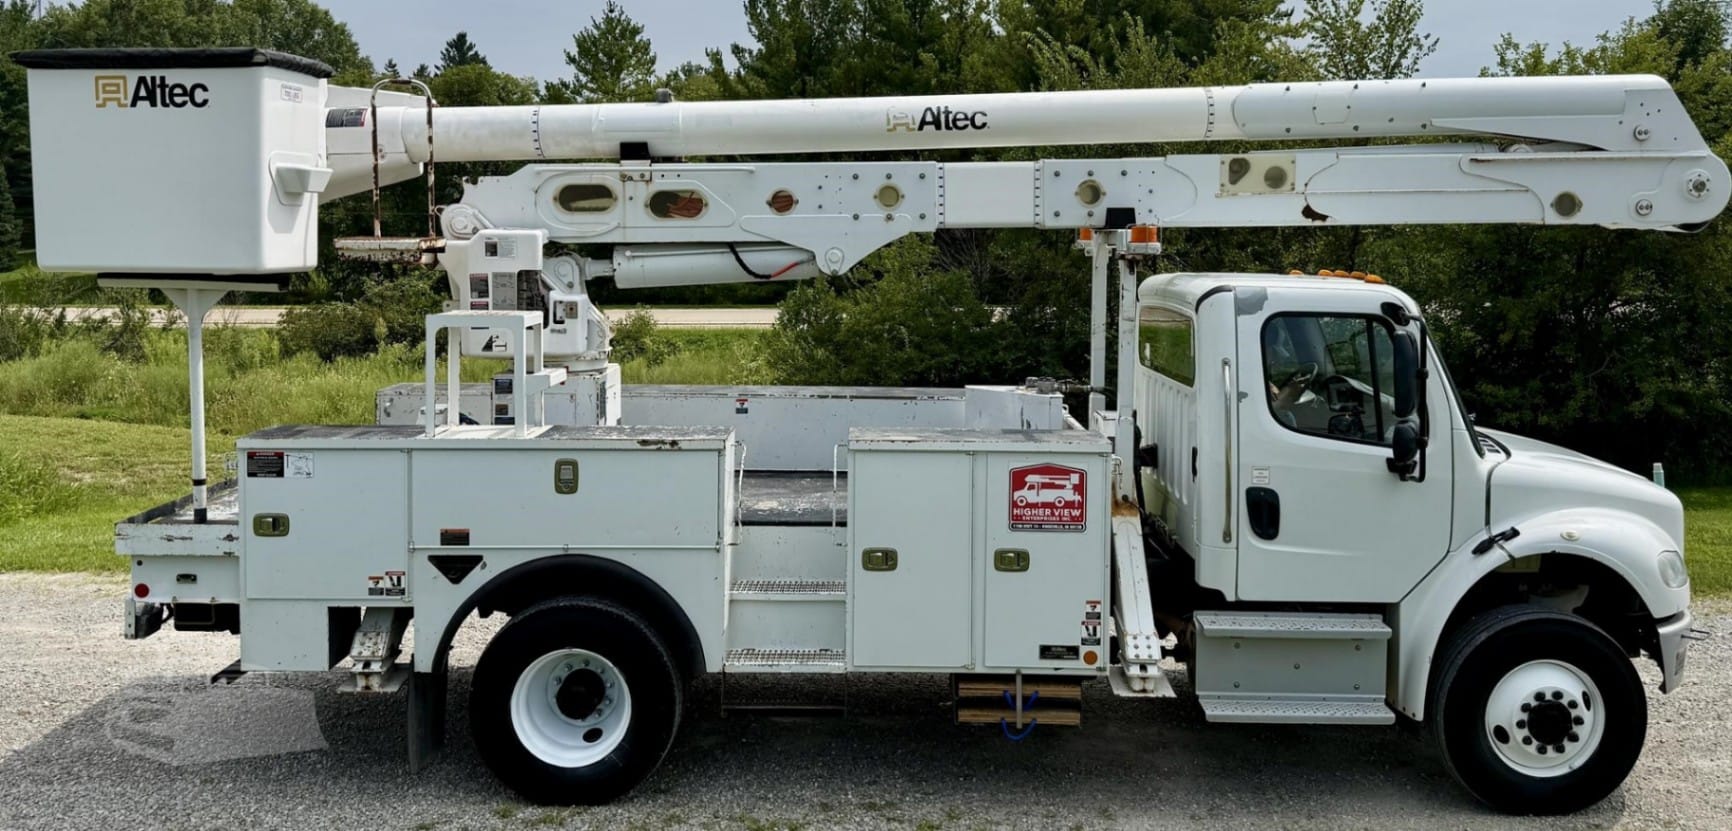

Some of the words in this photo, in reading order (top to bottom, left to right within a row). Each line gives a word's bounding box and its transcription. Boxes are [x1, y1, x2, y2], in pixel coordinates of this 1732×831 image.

[130, 75, 209, 108] Altec
[918, 105, 987, 131] Altec
[1013, 508, 1051, 516] HIGHER
[1053, 508, 1081, 516] VIEW
